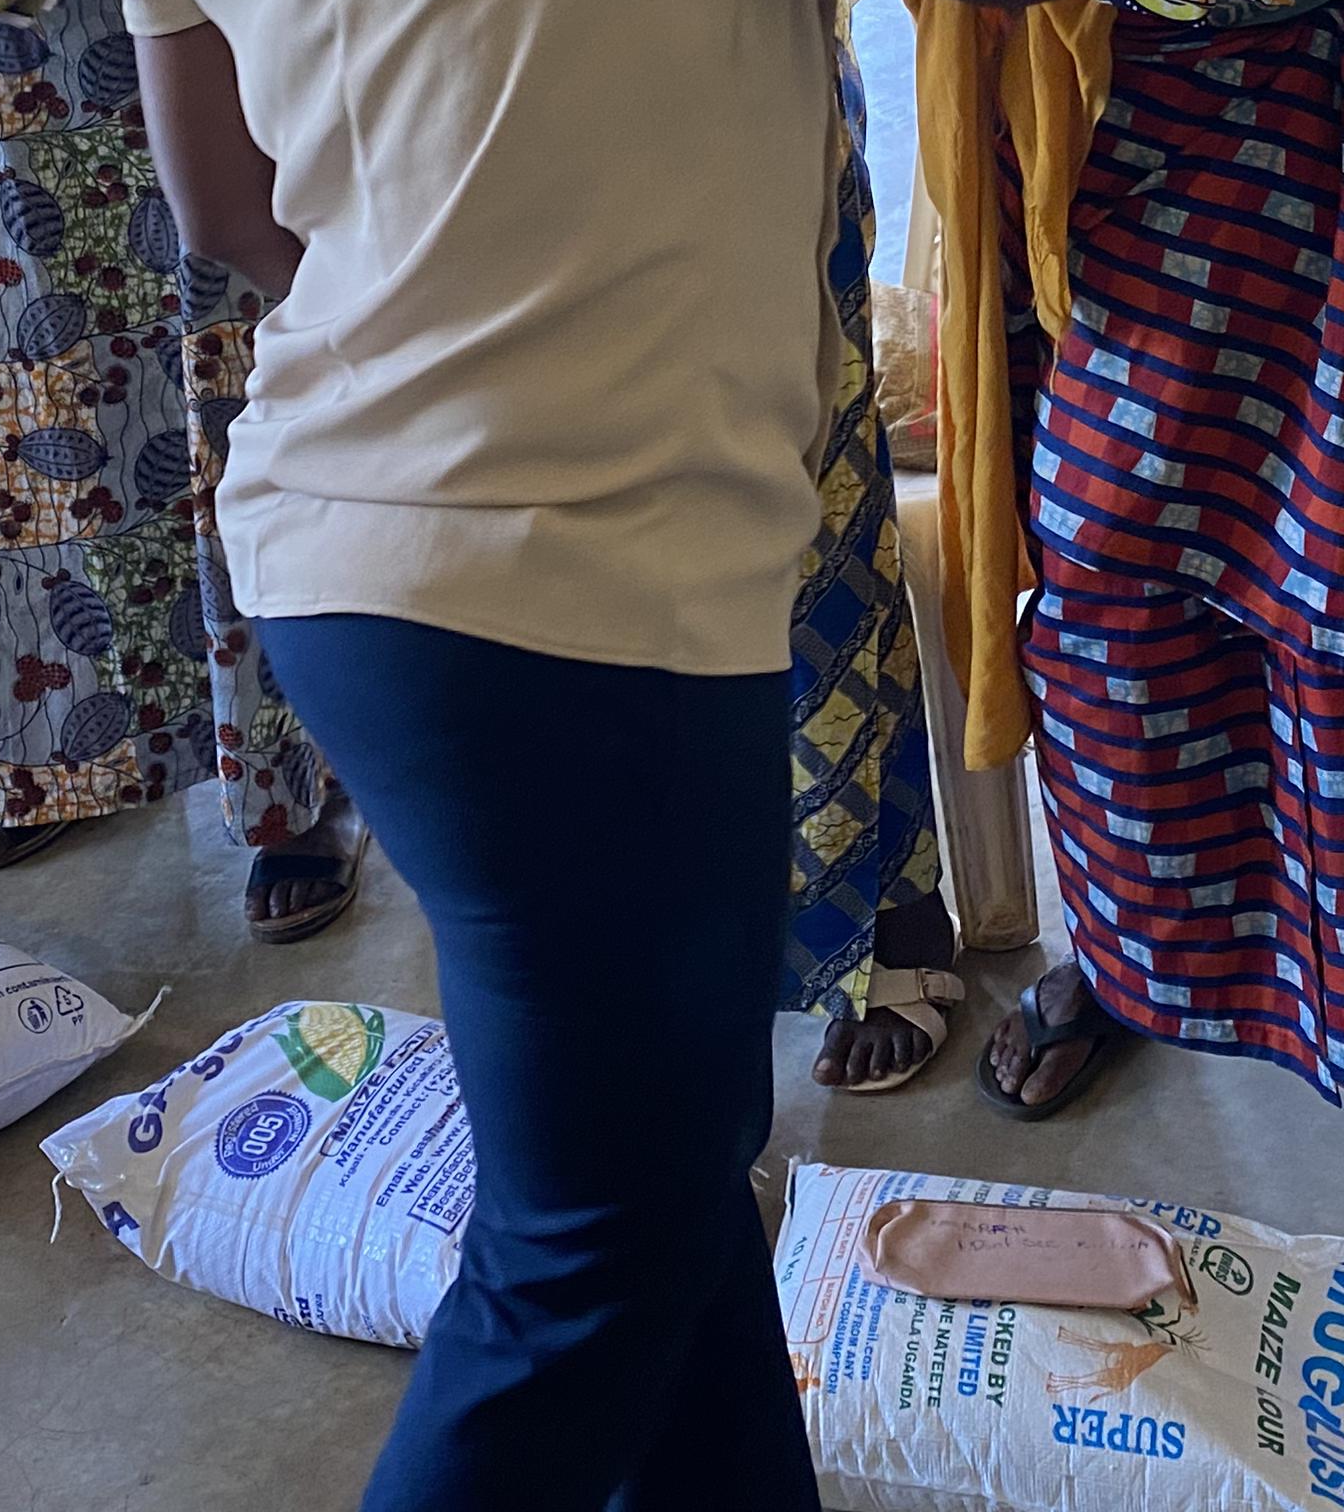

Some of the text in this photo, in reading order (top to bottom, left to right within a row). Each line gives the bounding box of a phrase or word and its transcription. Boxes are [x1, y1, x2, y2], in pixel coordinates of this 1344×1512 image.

[72, 1014, 84, 1026] PP
[242, 1114, 284, 1155] 005
[329, 1072, 386, 1142] MAIZE
[335, 1056, 424, 1167] Manufactured
[378, 1091, 428, 1147] Contact:
[337, 1152, 364, 1187] Kigali
[375, 1161, 411, 1208] Email:
[400, 1159, 433, 1195] Web:
[428, 1183, 458, 1216] Best
[827, 1301, 851, 1394] CONSUMPTION
[848, 1313, 864, 1345] FROM
[957, 1313, 987, 1396] LIMITED
[985, 1299, 1016, 1408] CKED BY
[1255, 1271, 1301, 1386] MAIZE
[843, 1348, 856, 1379] ANY
[899, 1340, 917, 1409] UGANDA
[927, 1326, 951, 1408] NATEETE
[1053, 1403, 1185, 1459] SUPER
